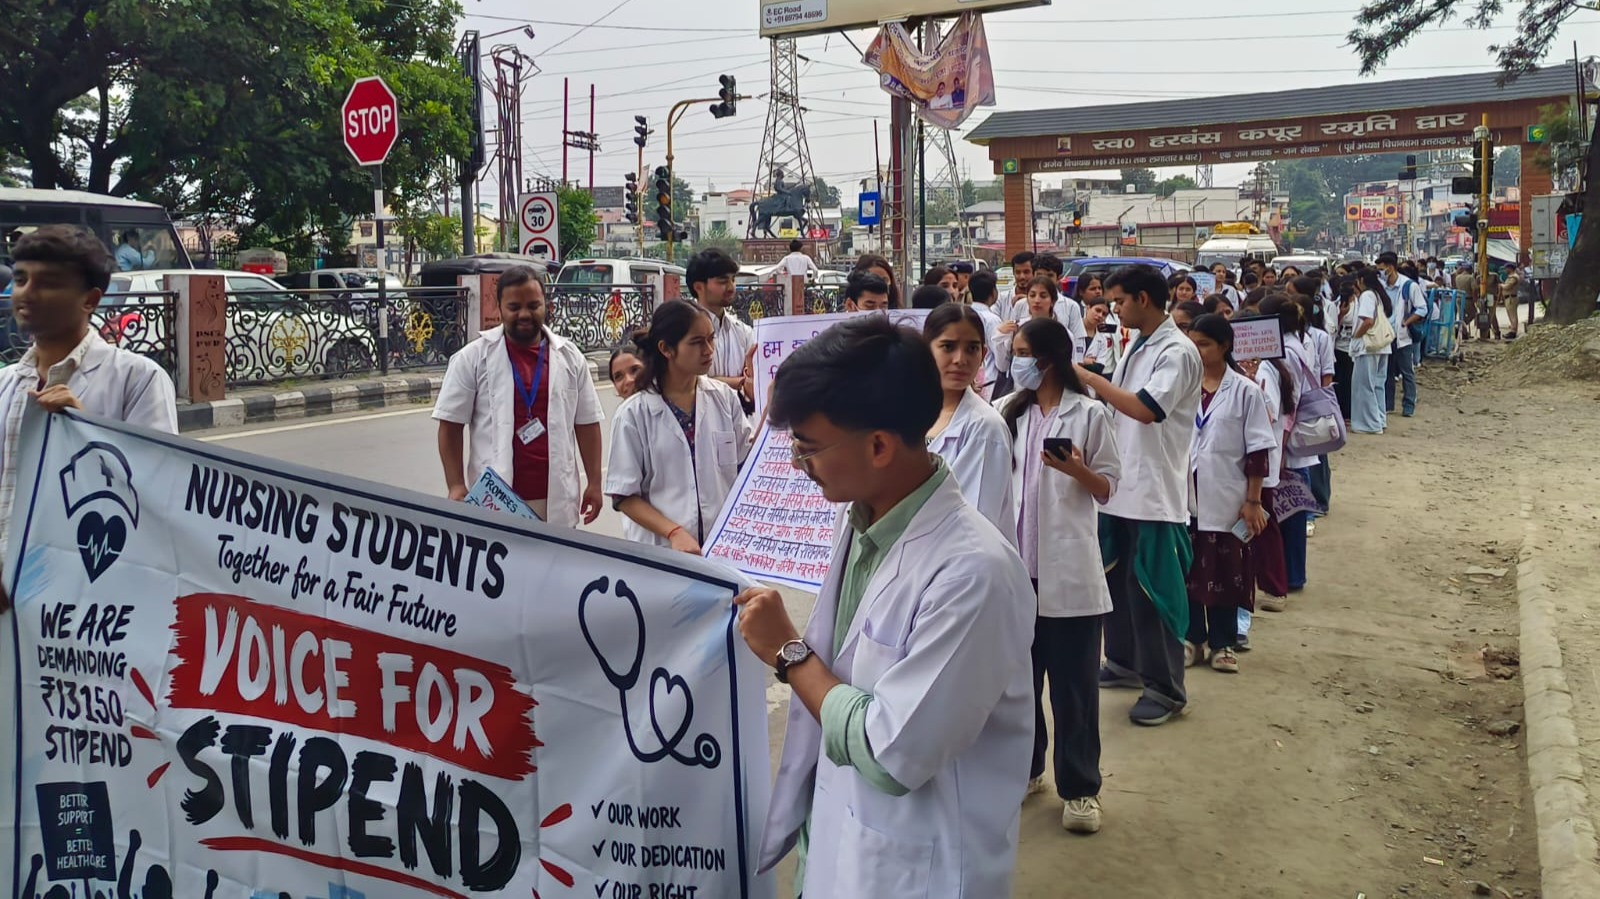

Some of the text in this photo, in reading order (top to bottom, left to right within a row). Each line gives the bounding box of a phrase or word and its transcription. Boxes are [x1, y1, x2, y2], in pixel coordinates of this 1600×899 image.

[784, 4, 801, 14] Road
[348, 104, 392, 138] STOP
[1148, 129, 1223, 148] हरबंस
[1237, 125, 1303, 142] कपूर
[1320, 114, 1399, 137] स्मृति
[1415, 112, 1469, 130] द्वार
[530, 215, 545, 228] 30
[762, 340, 785, 359] हम
[480, 471, 519, 513] PROMISES
[184, 463, 509, 599] NURSING STUDENTS
[217, 534, 457, 637] Together for a Fair Future
[40, 602, 135, 647] WE ARE
[37, 645, 128, 681] DEMANDING
[199, 603, 496, 760] VOICE FOR
[45, 725, 132, 767] STIPEND
[175, 715, 522, 892] STIPEND
[608, 802, 682, 830] OUR WORK
[56, 854, 107, 870] HEALTHCRE
[611, 840, 726, 872] OUR DEDICATION
[613, 880, 698, 899] OUR RIGHT
